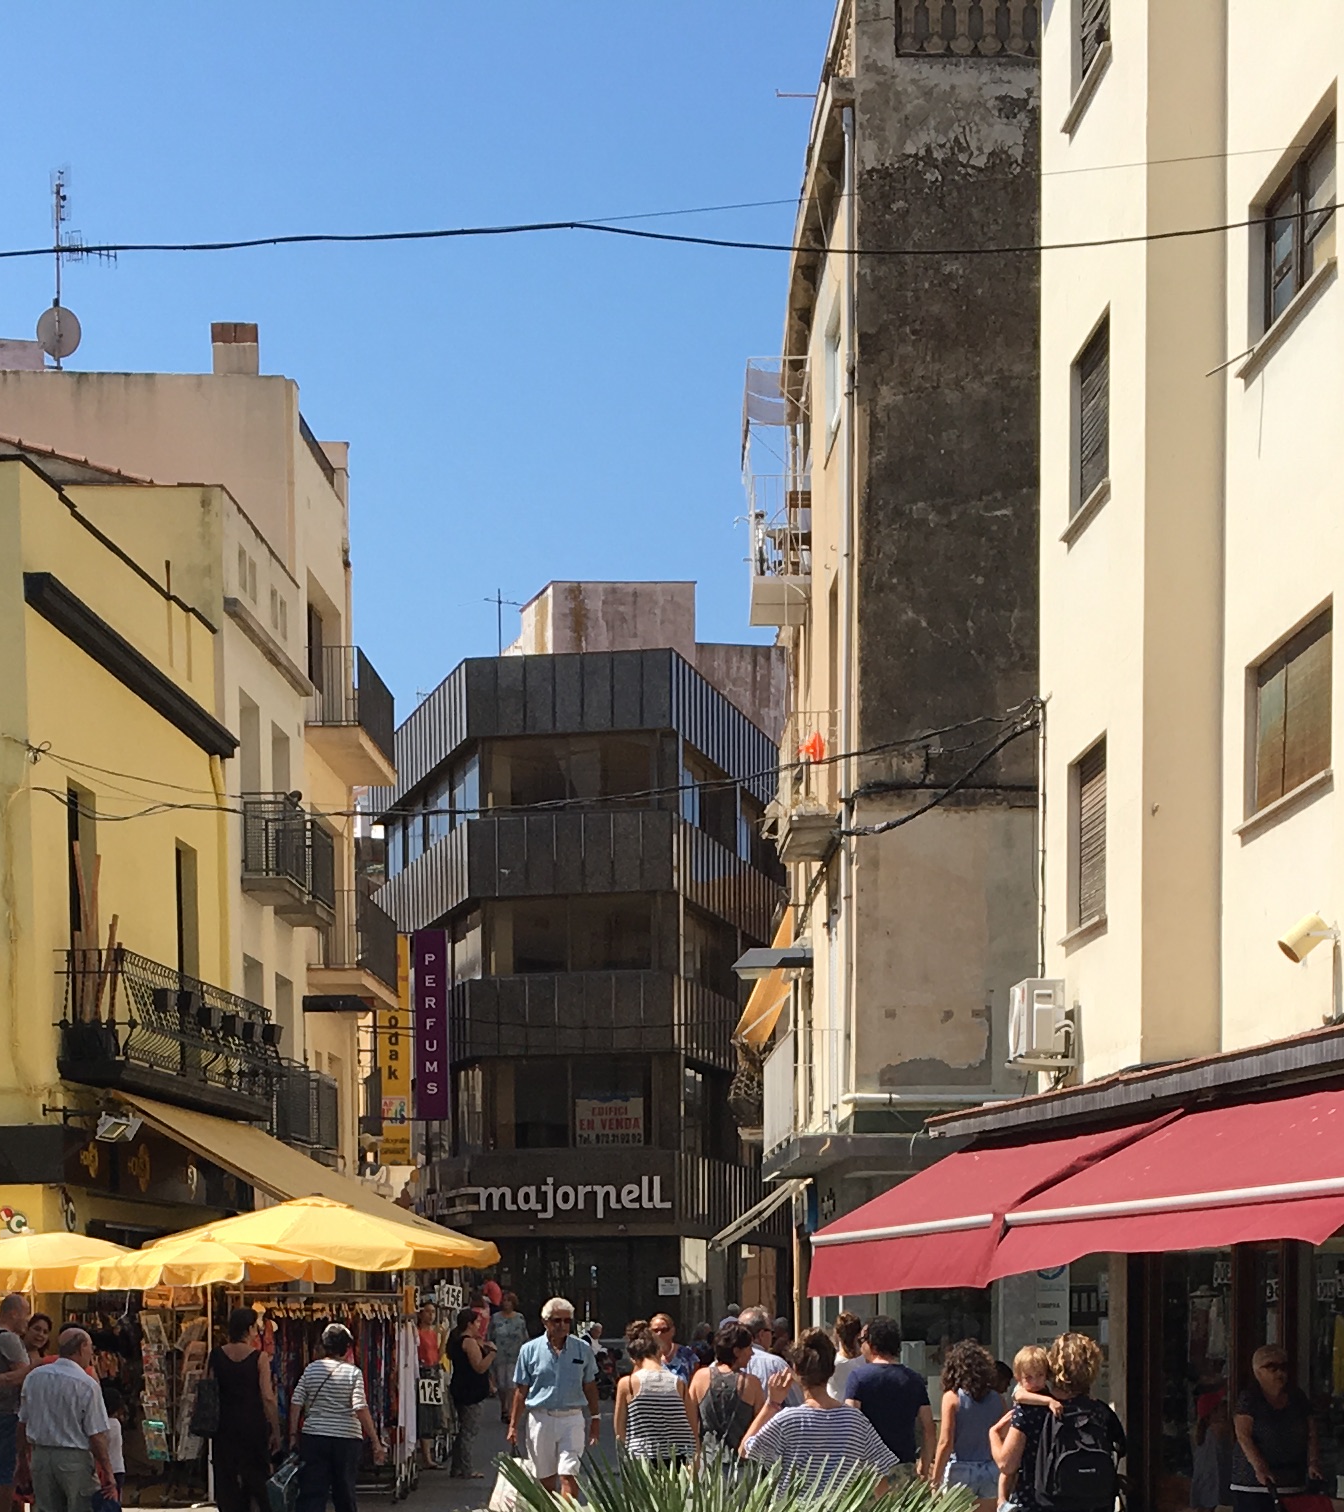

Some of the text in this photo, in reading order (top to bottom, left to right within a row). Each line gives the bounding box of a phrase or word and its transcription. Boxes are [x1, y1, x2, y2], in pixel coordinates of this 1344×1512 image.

[424, 952, 440, 1095] PERFUMS
[388, 1008, 400, 1081] odak
[591, 1105, 628, 1117] EDIFICI
[579, 1116, 641, 1131] EN VENDA
[445, 1286, 462, 1308] 15€
[420, 1380, 442, 1403] 12€
